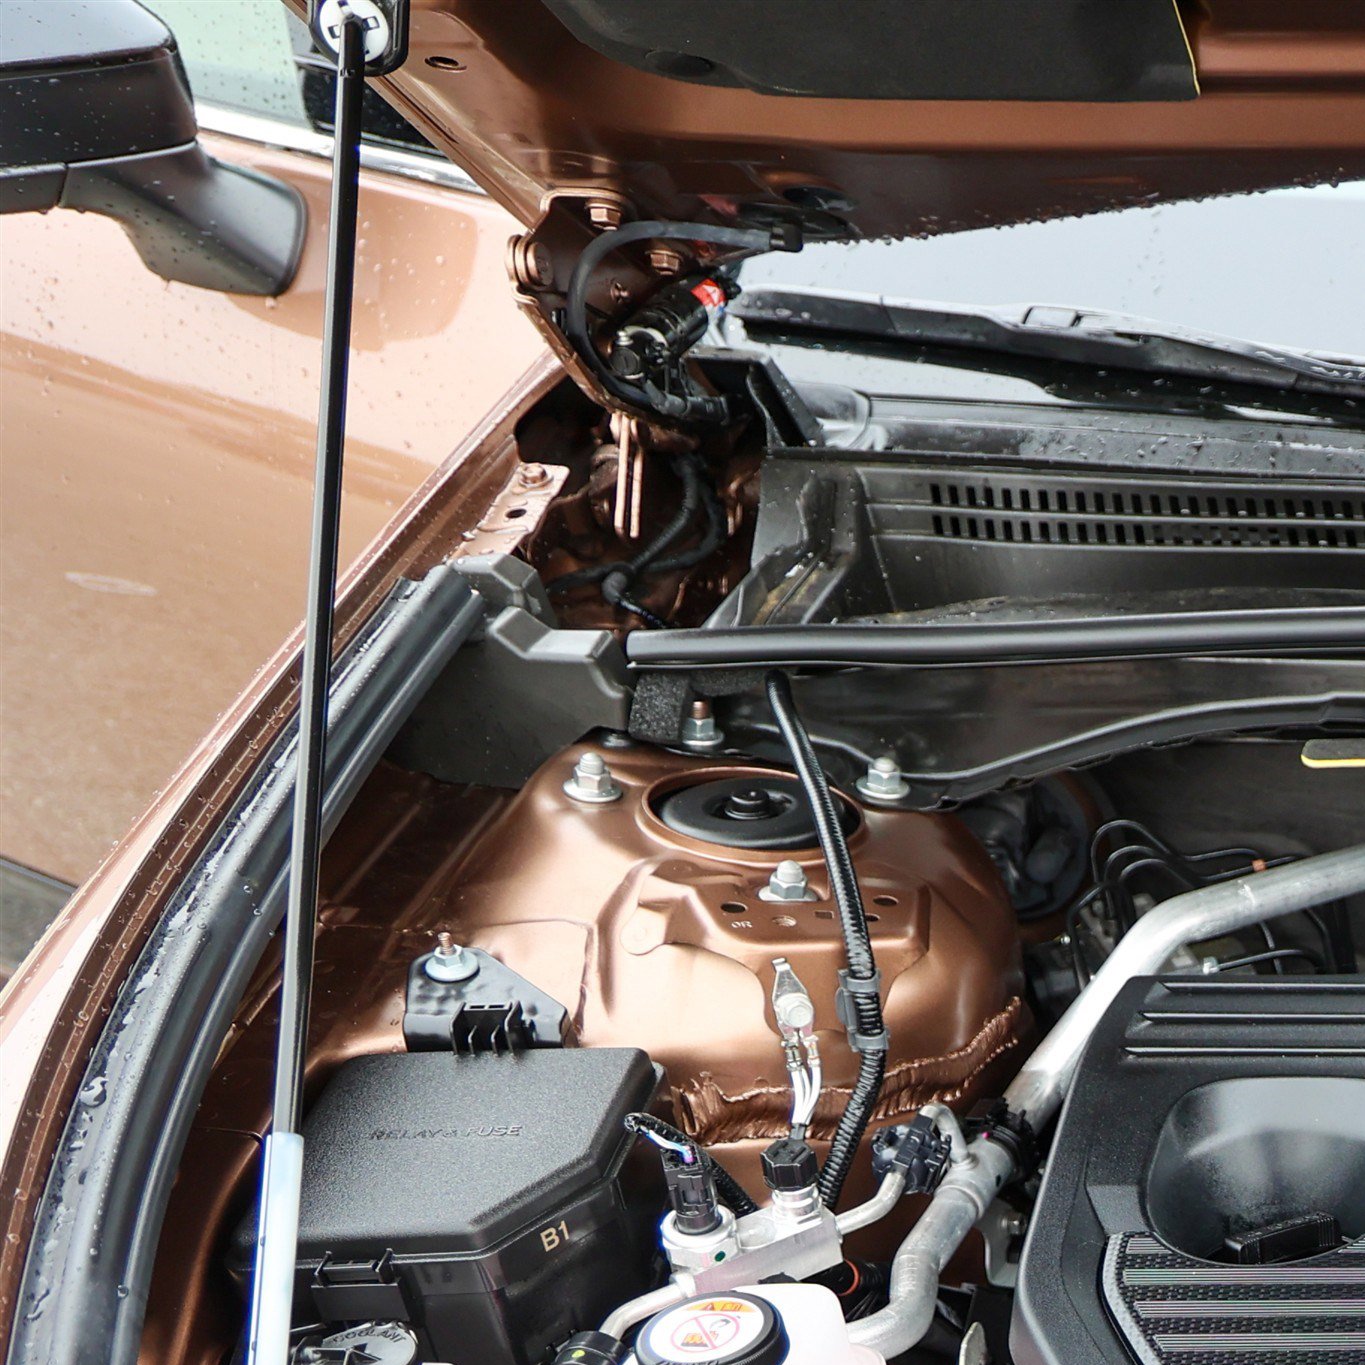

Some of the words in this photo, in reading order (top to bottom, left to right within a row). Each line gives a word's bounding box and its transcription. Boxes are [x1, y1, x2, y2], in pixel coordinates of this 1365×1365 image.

[464, 1124, 523, 1137] FUSE
[540, 1220, 570, 1253] B1
[332, 1328, 406, 1343] COOLANT
